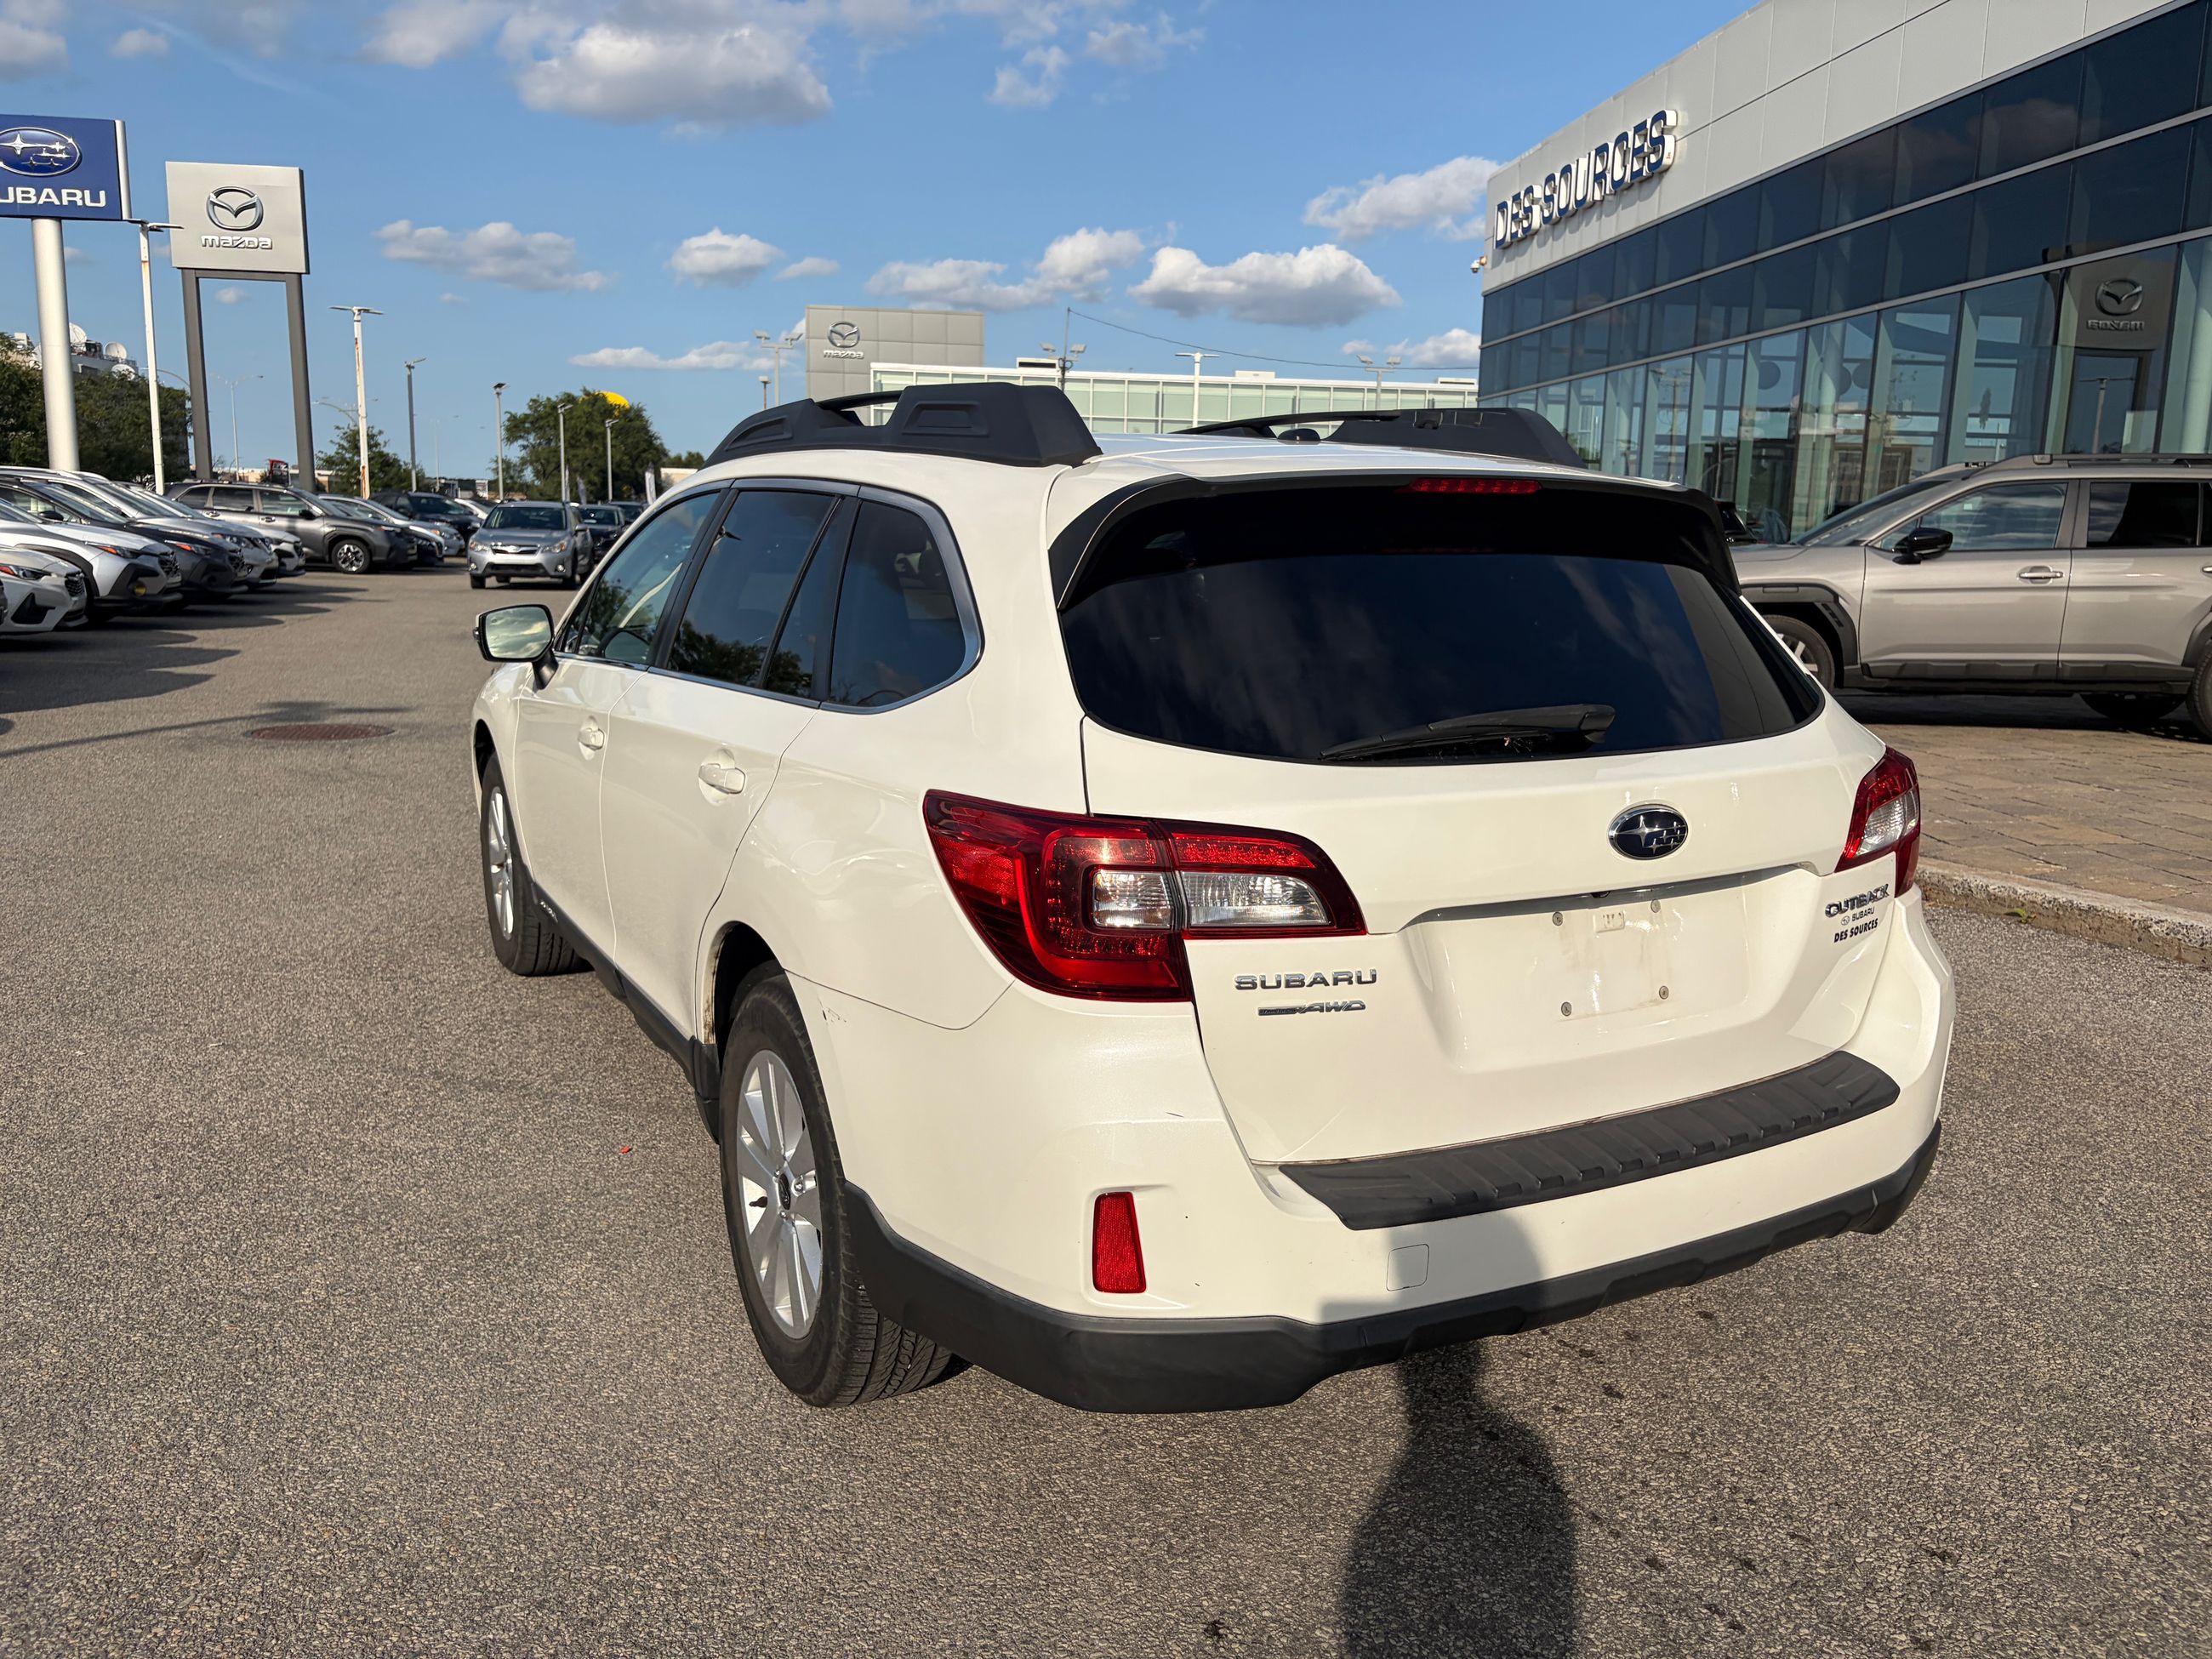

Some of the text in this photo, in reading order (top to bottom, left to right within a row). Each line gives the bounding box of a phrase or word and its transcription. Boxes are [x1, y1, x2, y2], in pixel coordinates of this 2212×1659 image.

[1494, 110, 1677, 249] DES SOURCES
[201, 235, 273, 250] mazda
[1825, 883, 1890, 918] OUTBACK
[1851, 906, 1875, 921] SUBARU
[1833, 918, 1878, 944] DES SOURCES
[1234, 968, 1377, 990] SUBARU
[1301, 1000, 1366, 1014] AWD
